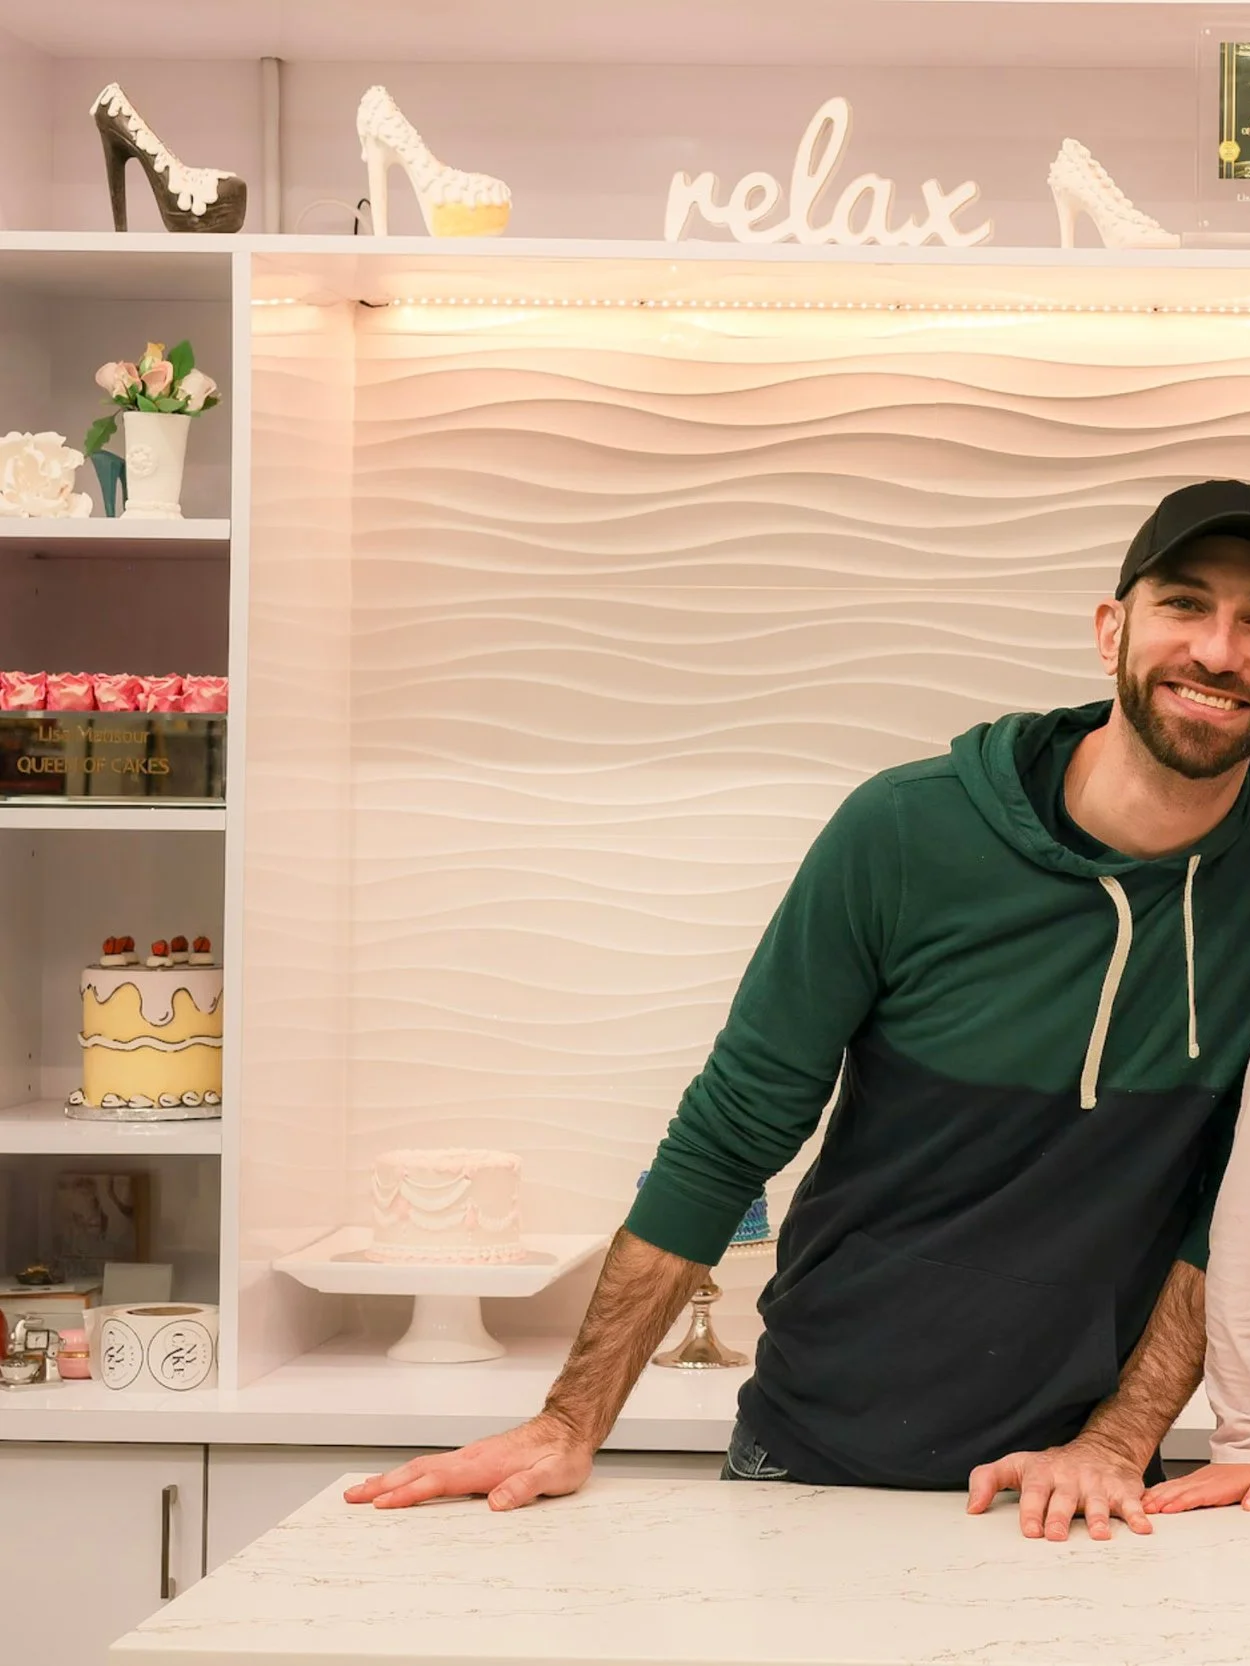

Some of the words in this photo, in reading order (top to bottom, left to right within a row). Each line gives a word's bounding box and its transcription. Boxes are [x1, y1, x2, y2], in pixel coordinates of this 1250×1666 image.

[1241, 127, 1250, 135] OF
[664, 97, 994, 247] relax
[17, 755, 80, 775] QUEEN
[83, 757, 107, 773] OF
[111, 757, 170, 775] CAKES
